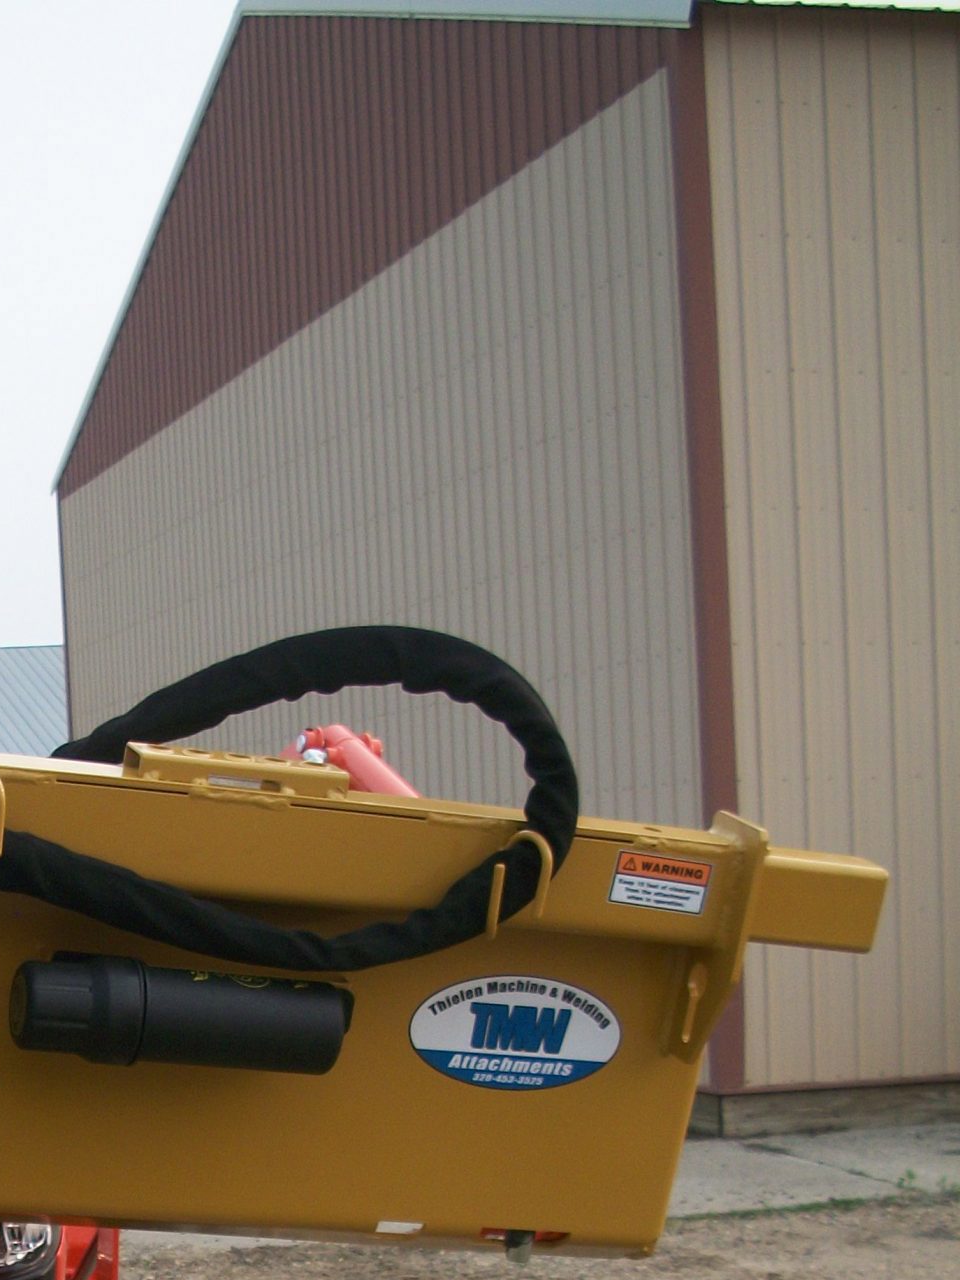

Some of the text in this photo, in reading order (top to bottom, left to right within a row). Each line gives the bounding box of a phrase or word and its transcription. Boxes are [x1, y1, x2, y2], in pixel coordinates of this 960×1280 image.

[641, 861, 703, 879] WARNING
[428, 980, 611, 1030] Thielen Machine & Welding
[470, 1001, 572, 1054] TMW
[448, 1054, 573, 1076] Attachments
